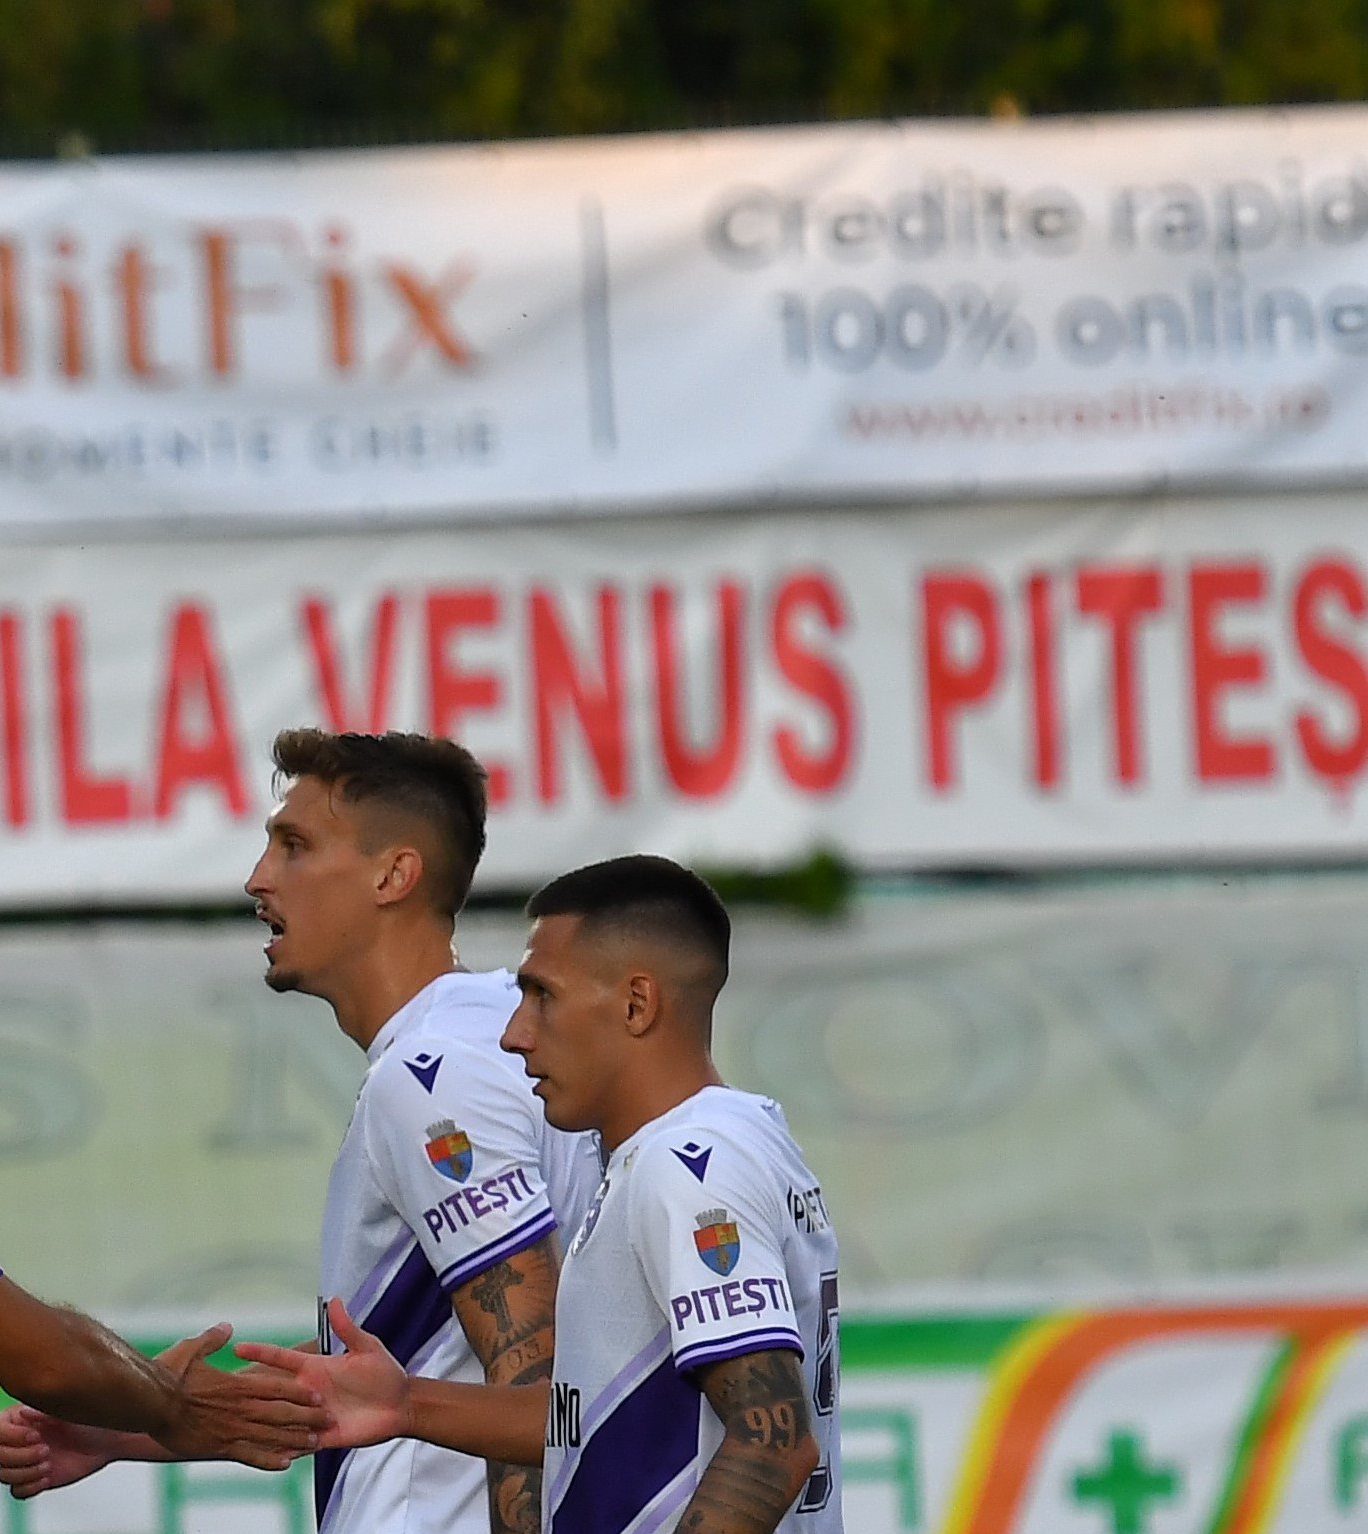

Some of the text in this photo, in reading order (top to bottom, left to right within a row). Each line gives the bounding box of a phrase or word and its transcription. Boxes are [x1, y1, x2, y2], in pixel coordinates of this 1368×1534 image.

[704, 168, 1085, 272] Credite
[779, 282, 1039, 376] 100%
[301, 566, 859, 810] VENUS
[670, 1278, 790, 1332] PITEȘTI
